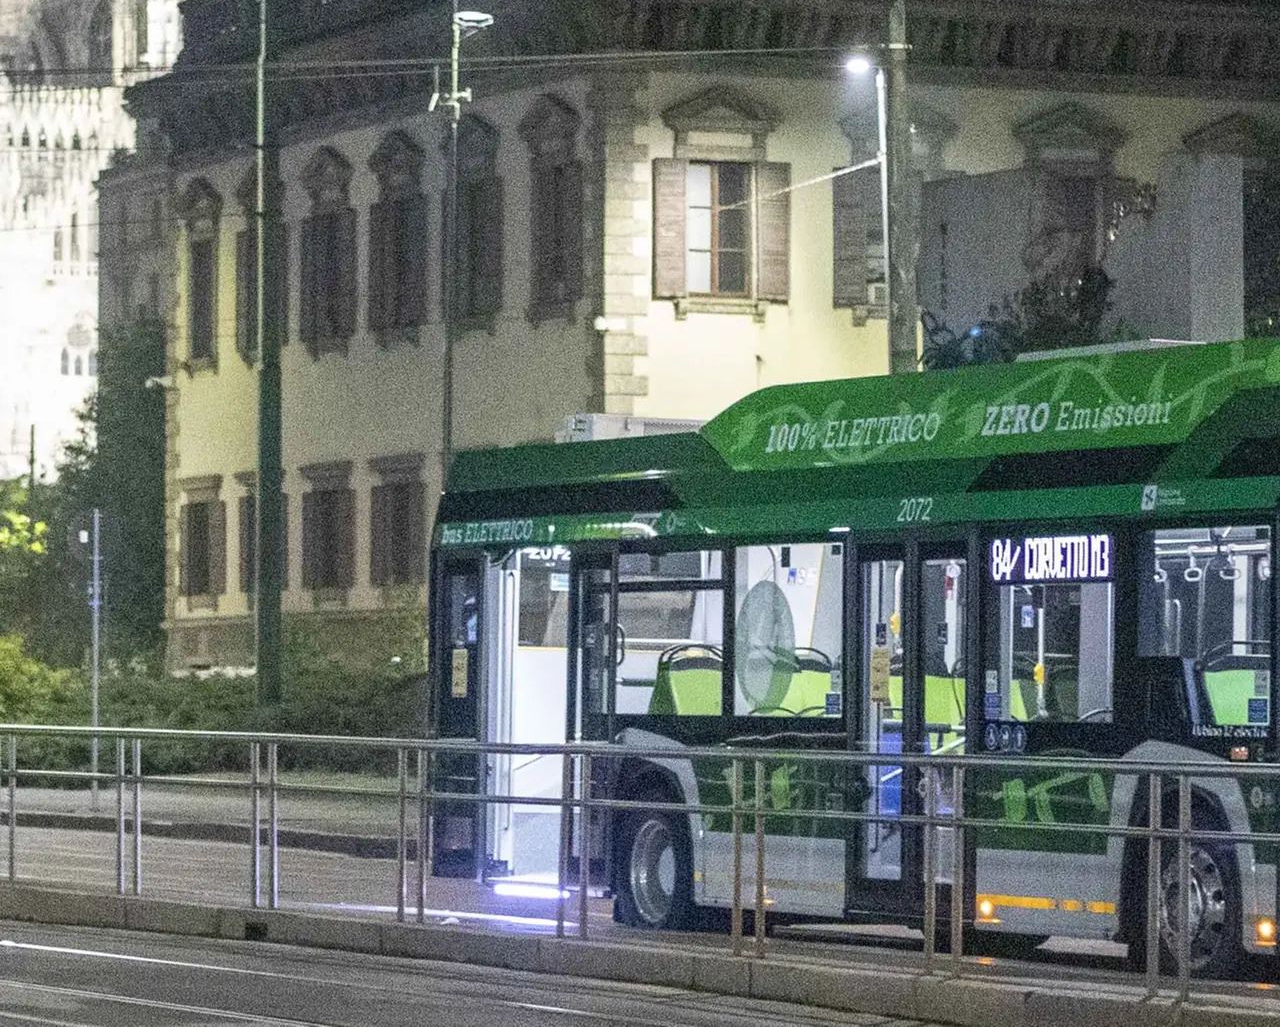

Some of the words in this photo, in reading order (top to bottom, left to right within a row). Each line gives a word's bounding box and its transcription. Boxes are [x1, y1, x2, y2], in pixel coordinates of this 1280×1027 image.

[765, 422, 818, 453] 100%
[821, 412, 941, 449] ELETTRICO
[980, 402, 1050, 436] ZERO
[1055, 392, 1175, 432] Emissioni
[896, 497, 935, 522] 2072
[441, 524, 463, 545] bus
[465, 519, 533, 543] ELETTRICO
[1024, 535, 1089, 580] CORVETTO
